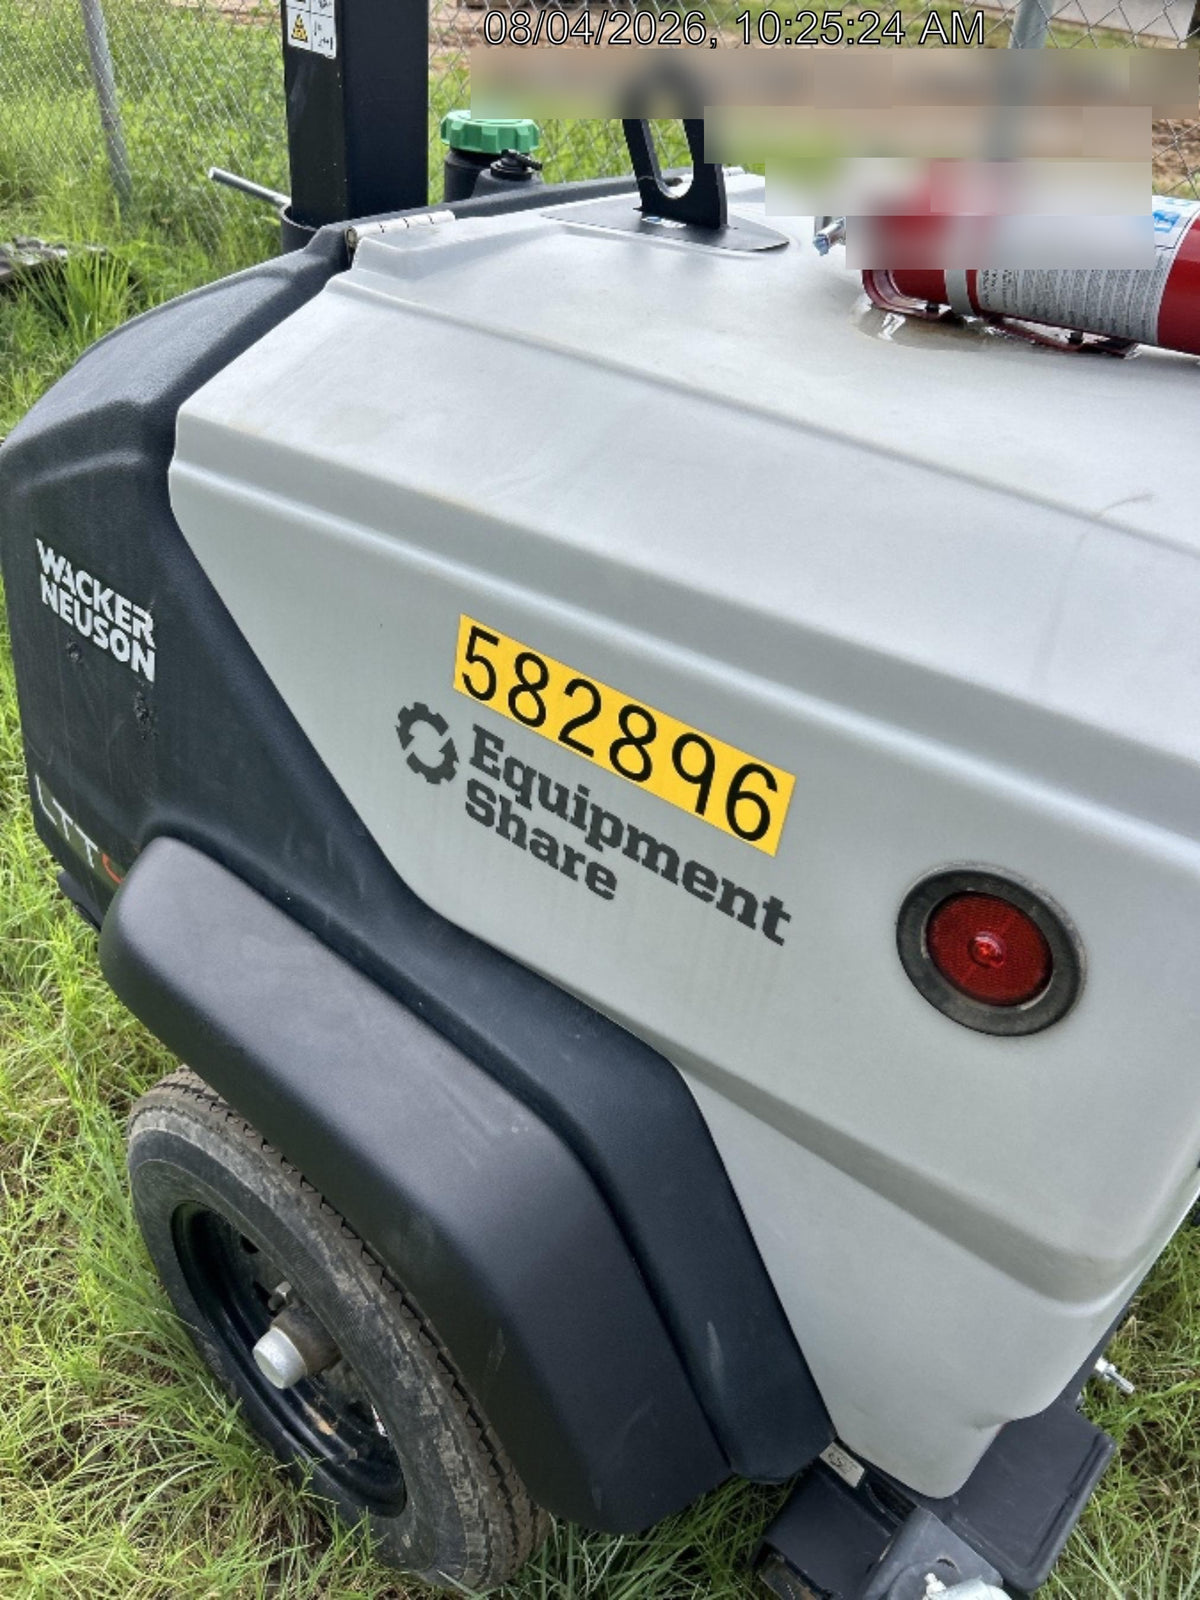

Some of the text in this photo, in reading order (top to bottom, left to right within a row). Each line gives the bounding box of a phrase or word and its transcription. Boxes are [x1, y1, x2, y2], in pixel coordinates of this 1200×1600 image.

[36, 538, 157, 649] WACKER
[40, 573, 155, 682] NEUSON
[461, 625, 779, 842] 582896
[465, 778, 618, 900] Share
[469, 723, 792, 946] Equipment
